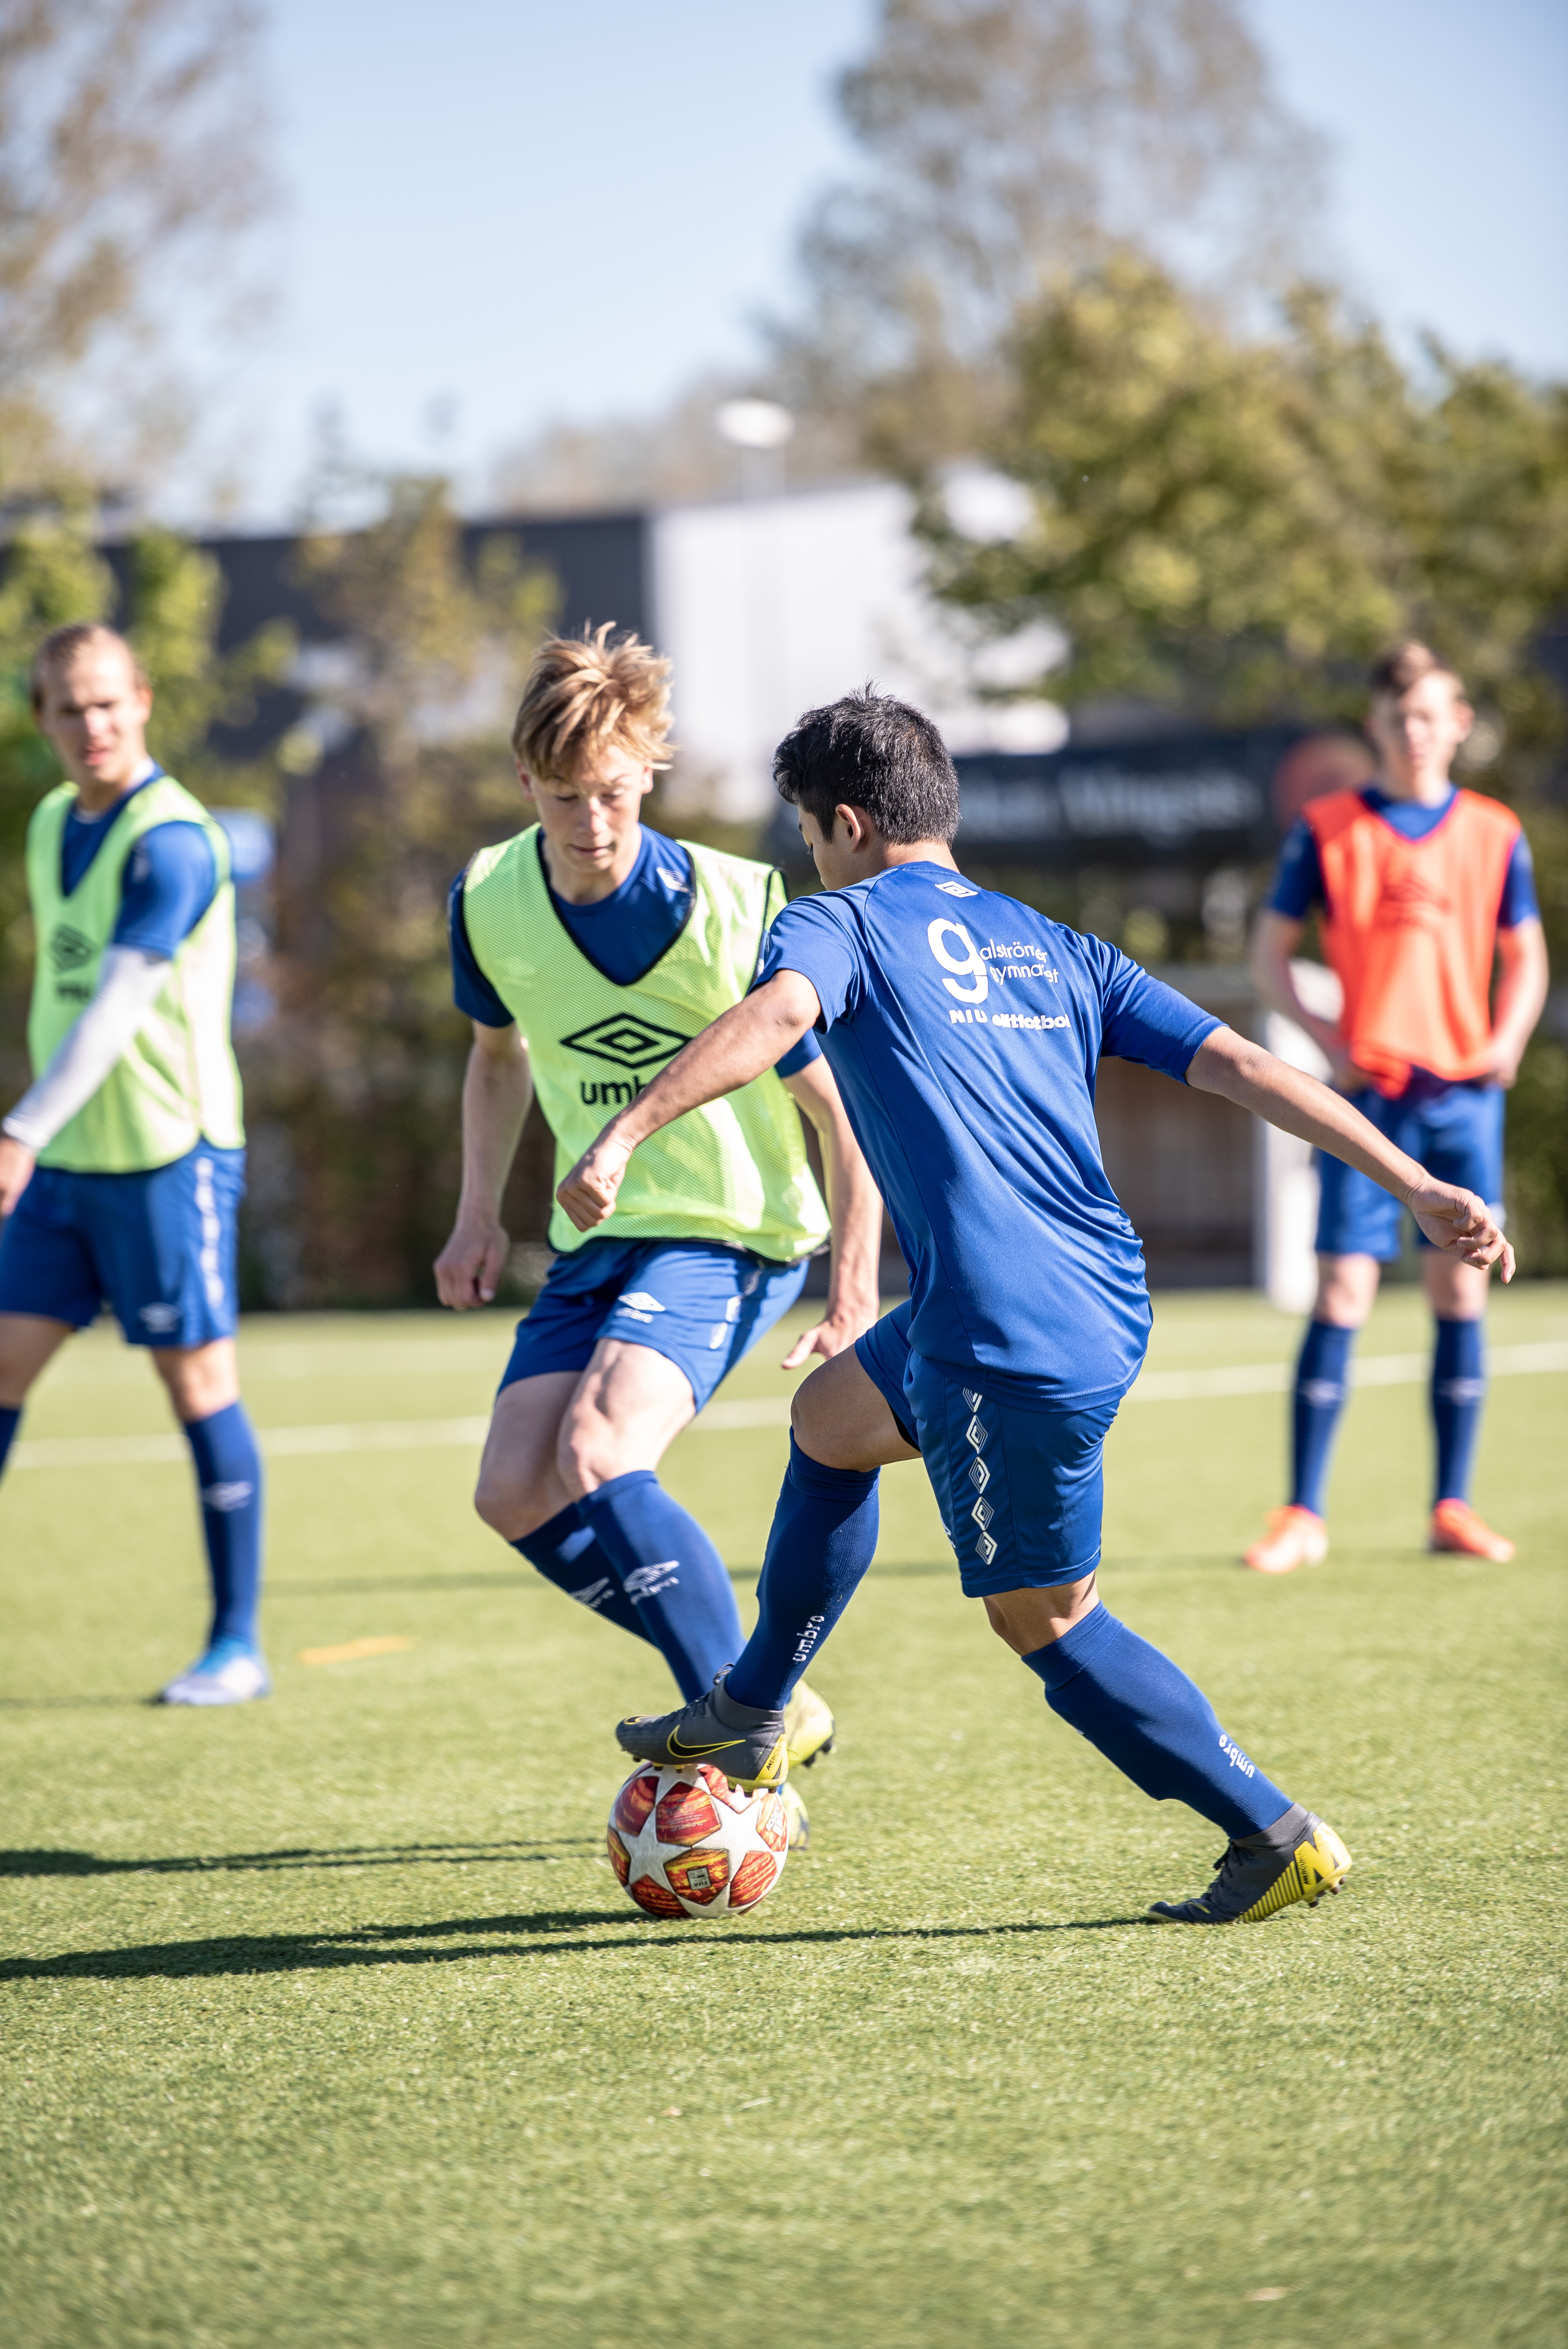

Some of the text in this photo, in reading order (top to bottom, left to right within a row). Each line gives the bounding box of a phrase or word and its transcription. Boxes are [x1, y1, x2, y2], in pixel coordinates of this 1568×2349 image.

[989, 964, 1058, 986] gymnaet
[949, 1009, 988, 1023] NIU
[792, 1616, 824, 1661] umbro
[1219, 1734, 1255, 1778] umbro
